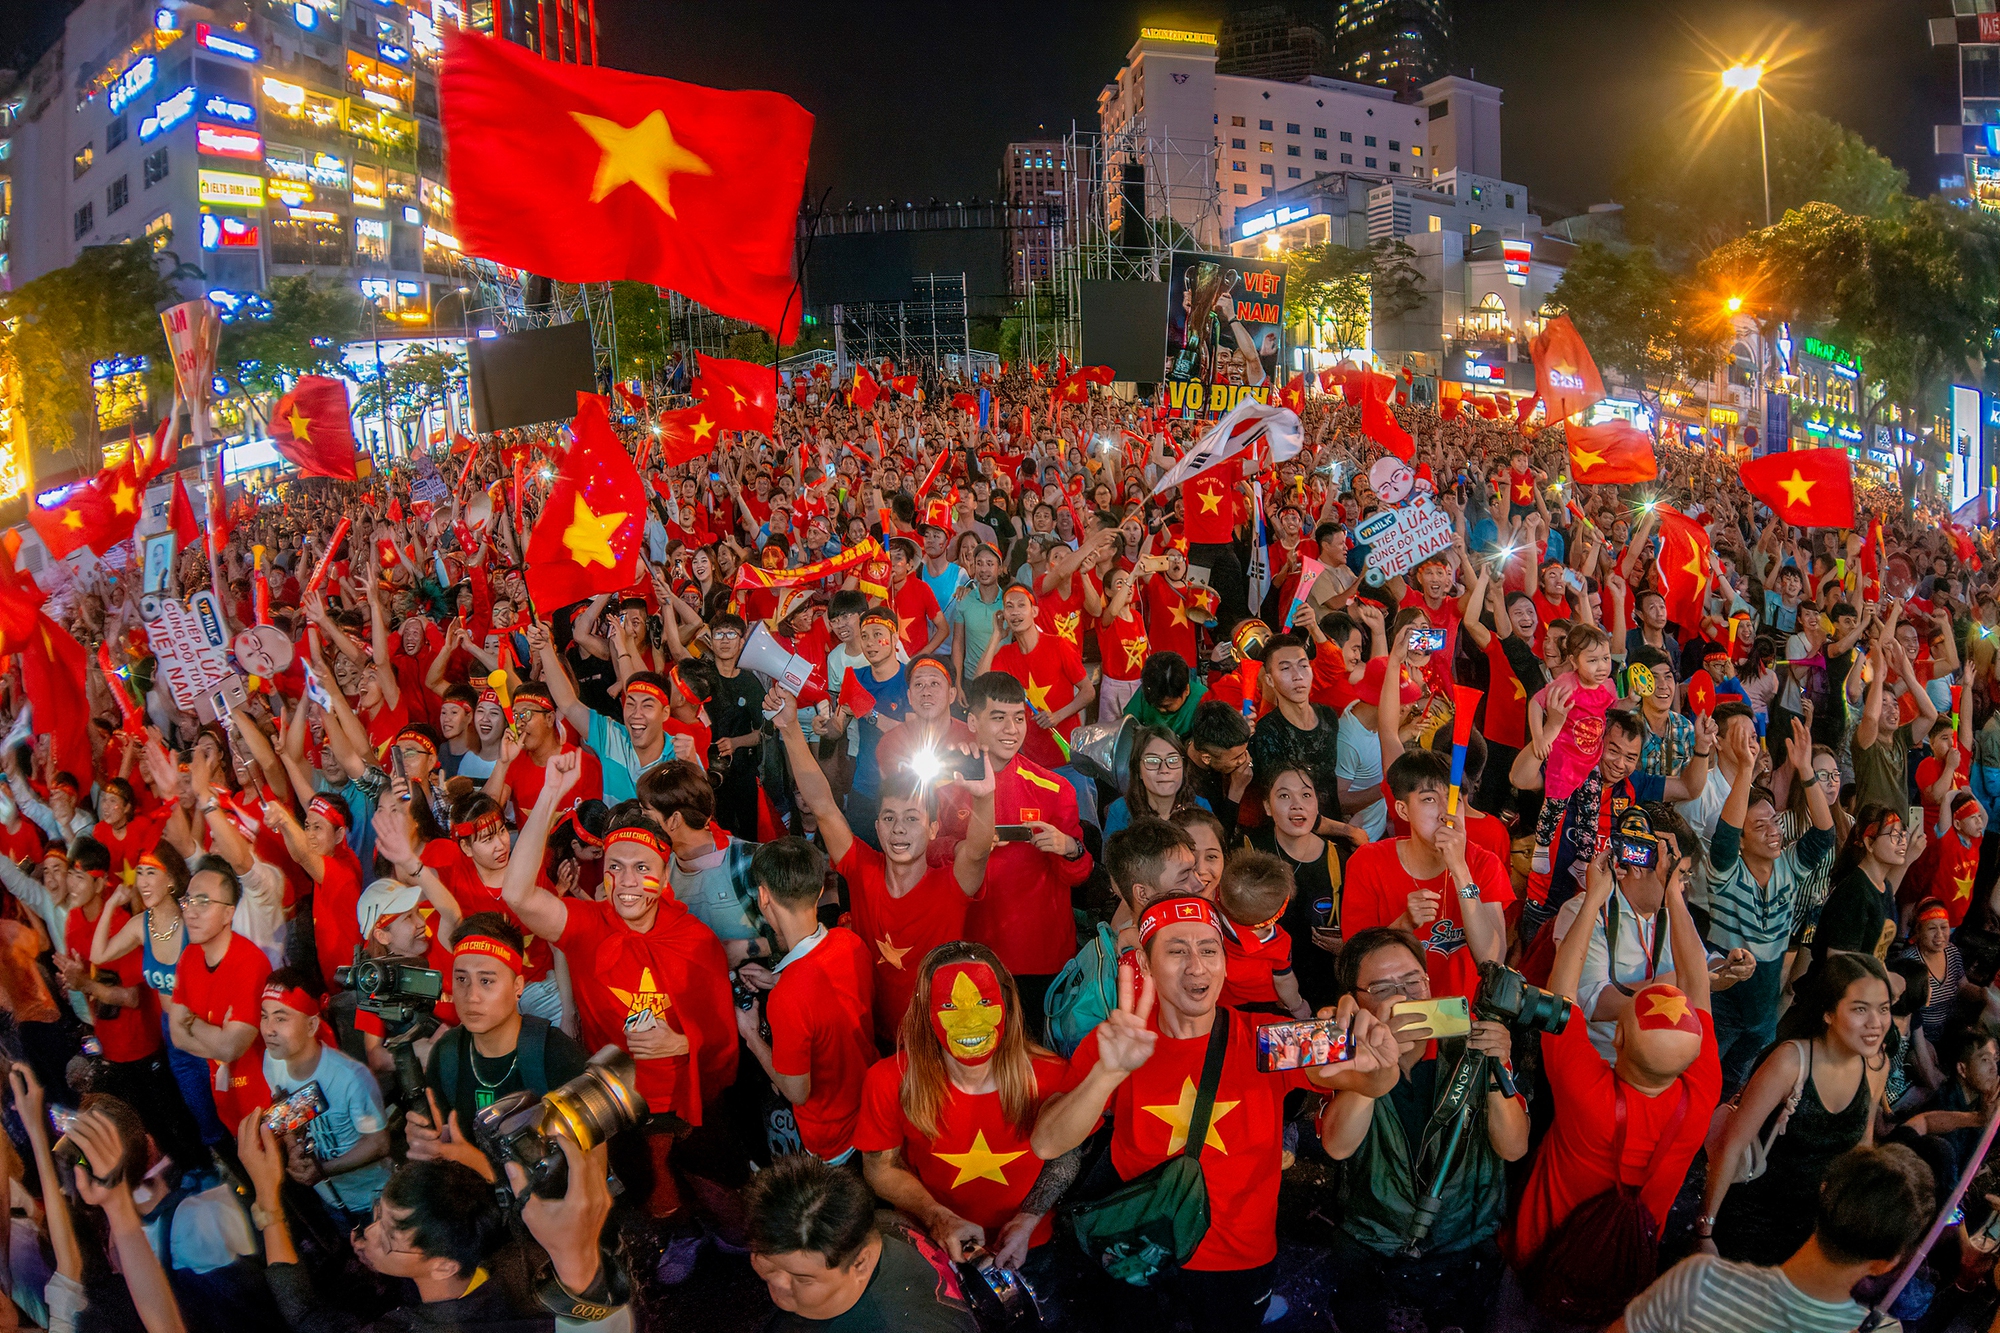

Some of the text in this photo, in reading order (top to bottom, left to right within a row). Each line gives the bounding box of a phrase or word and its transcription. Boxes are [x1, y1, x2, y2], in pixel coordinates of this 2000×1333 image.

[1243, 269, 1281, 298] VIỆT
[1237, 301, 1280, 324] NAM
[1169, 377, 1204, 410] VÔ
[1361, 514, 1394, 538] VPMILK
[1368, 513, 1448, 566] CÙNG ĐỘI TUYỂN
[1376, 509, 1429, 549] TIẾP LỬA
[1381, 527, 1452, 577] VIỆT NAM
[184, 615, 202, 644] TIẾP
[197, 598, 222, 647] VPMILK
[147, 617, 195, 710] VIỆT NAM
[469, 940, 491, 952] CHIẾN
[633, 993, 663, 1004] VIET
